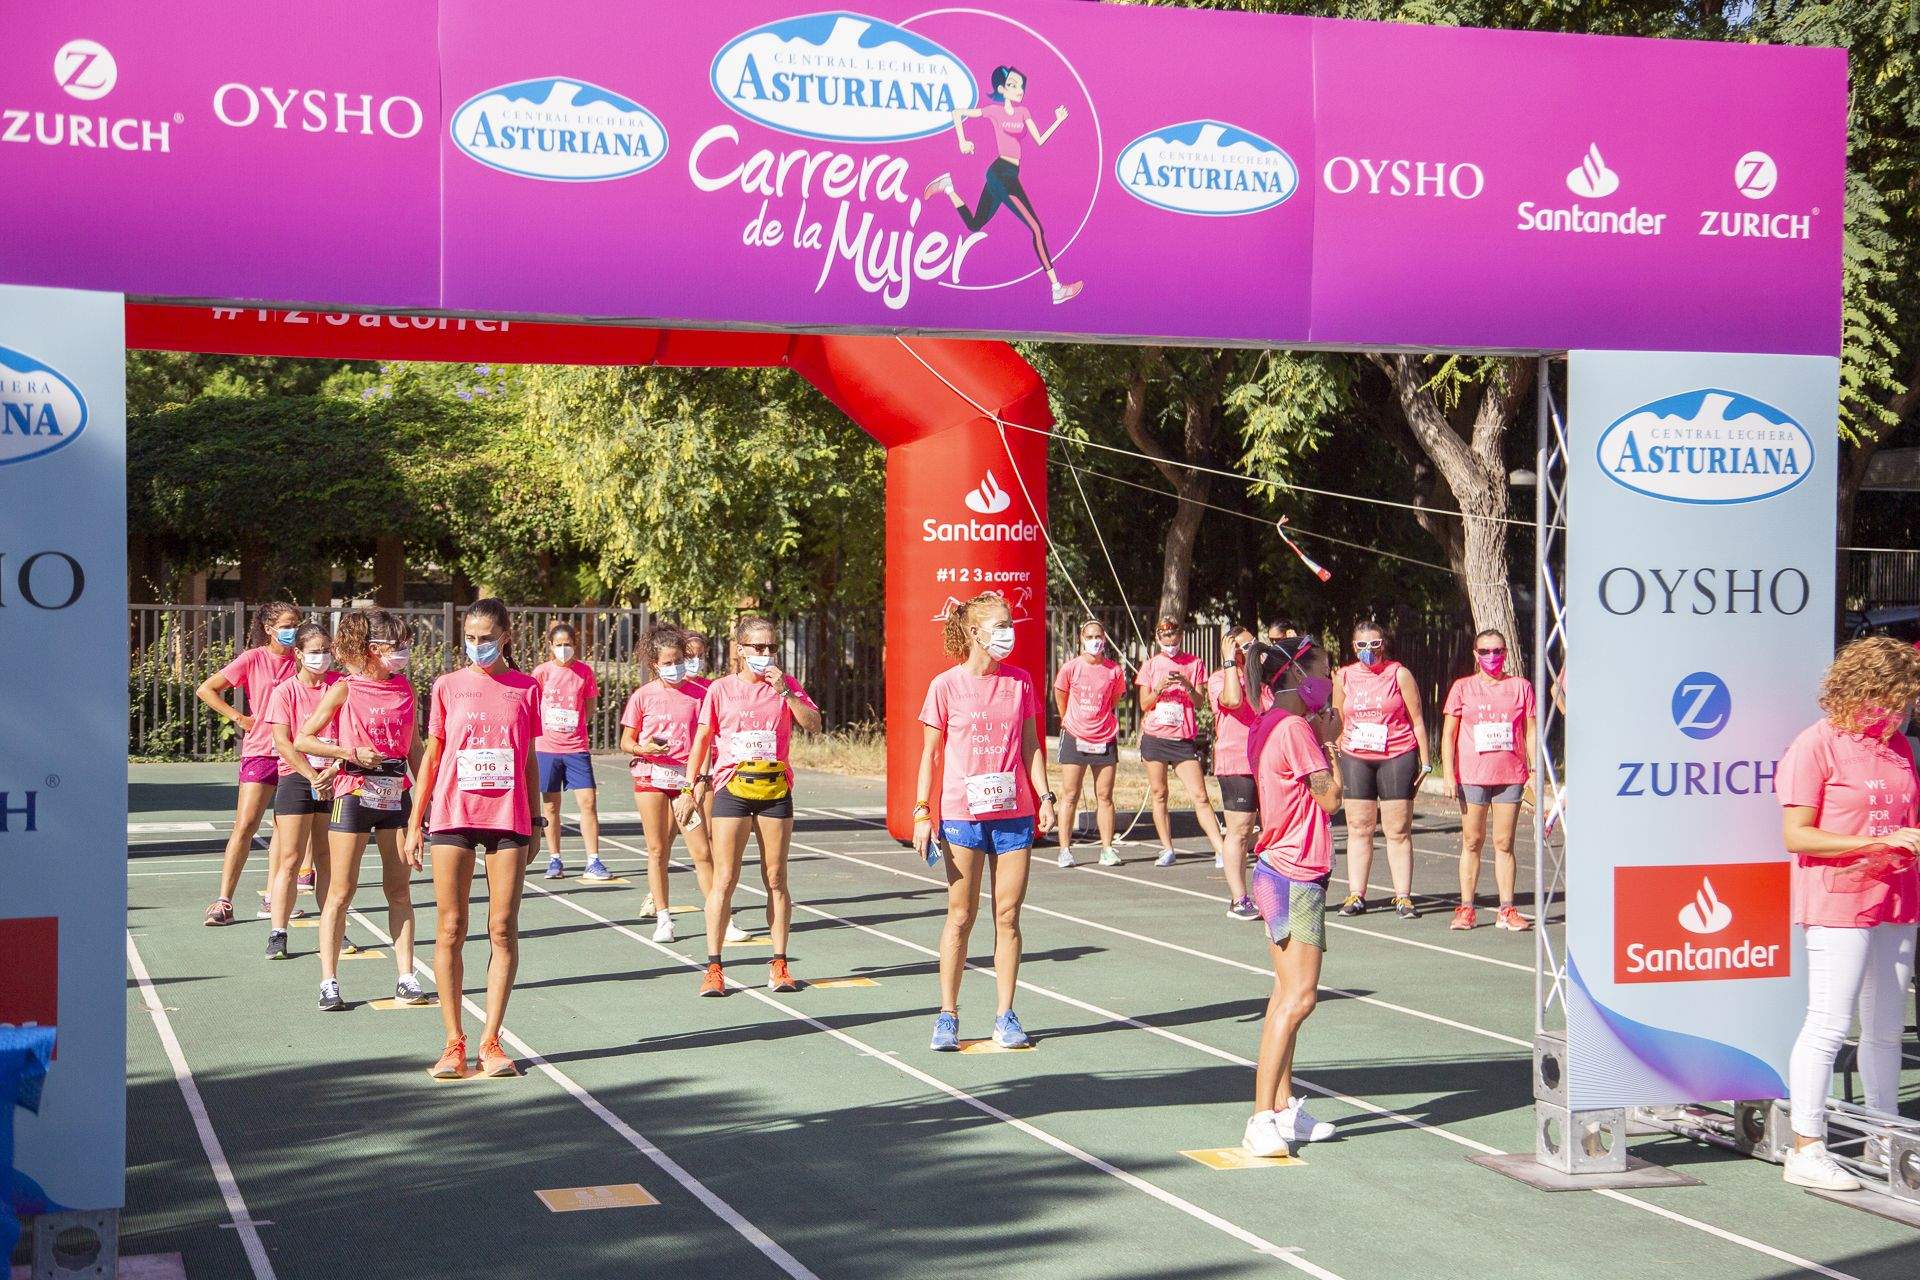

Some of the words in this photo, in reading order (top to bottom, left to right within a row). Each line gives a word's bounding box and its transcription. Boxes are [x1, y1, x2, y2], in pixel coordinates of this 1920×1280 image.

[774, 52, 858, 69] CENTRAL
[866, 58, 949, 76] LECHERA
[733, 53, 957, 112] ASTURIANA
[213, 83, 423, 139] OYSHO
[502, 110, 568, 123] CENTRAL
[578, 115, 645, 128] LECHERA
[470, 109, 651, 157] ASTURIANA
[688, 124, 910, 203] Carrera
[1159, 151, 1218, 163] CENTRAL
[1221, 154, 1279, 167] LECHERA
[1131, 152, 1284, 194] ASTURIANA
[1323, 156, 1484, 200] OYSHO
[1517, 201, 1667, 235] Santander
[743, 200, 784, 247] de
[793, 198, 822, 250] la
[814, 198, 988, 310] Mujer
[1651, 428, 1721, 440] CENTRAL
[1728, 429, 1795, 441] LECHERA
[1614, 430, 1800, 475] ASTURIANA
[922, 518, 1039, 542] Santander
[1598, 567, 1810, 616] OYSHO
[466, 711, 486, 721] WE
[970, 711, 988, 719] WE
[745, 741, 763, 749] 016
[972, 734, 990, 743] FOR
[973, 745, 1008, 755] REASON
[474, 762, 496, 772] 016
[1616, 760, 1777, 798] ZURICH
[376, 787, 392, 796] 016
[983, 785, 1003, 796] 016
[1864, 779, 1887, 790] WE
[1869, 810, 1890, 820] FOR
[1626, 939, 1780, 974] Santander
